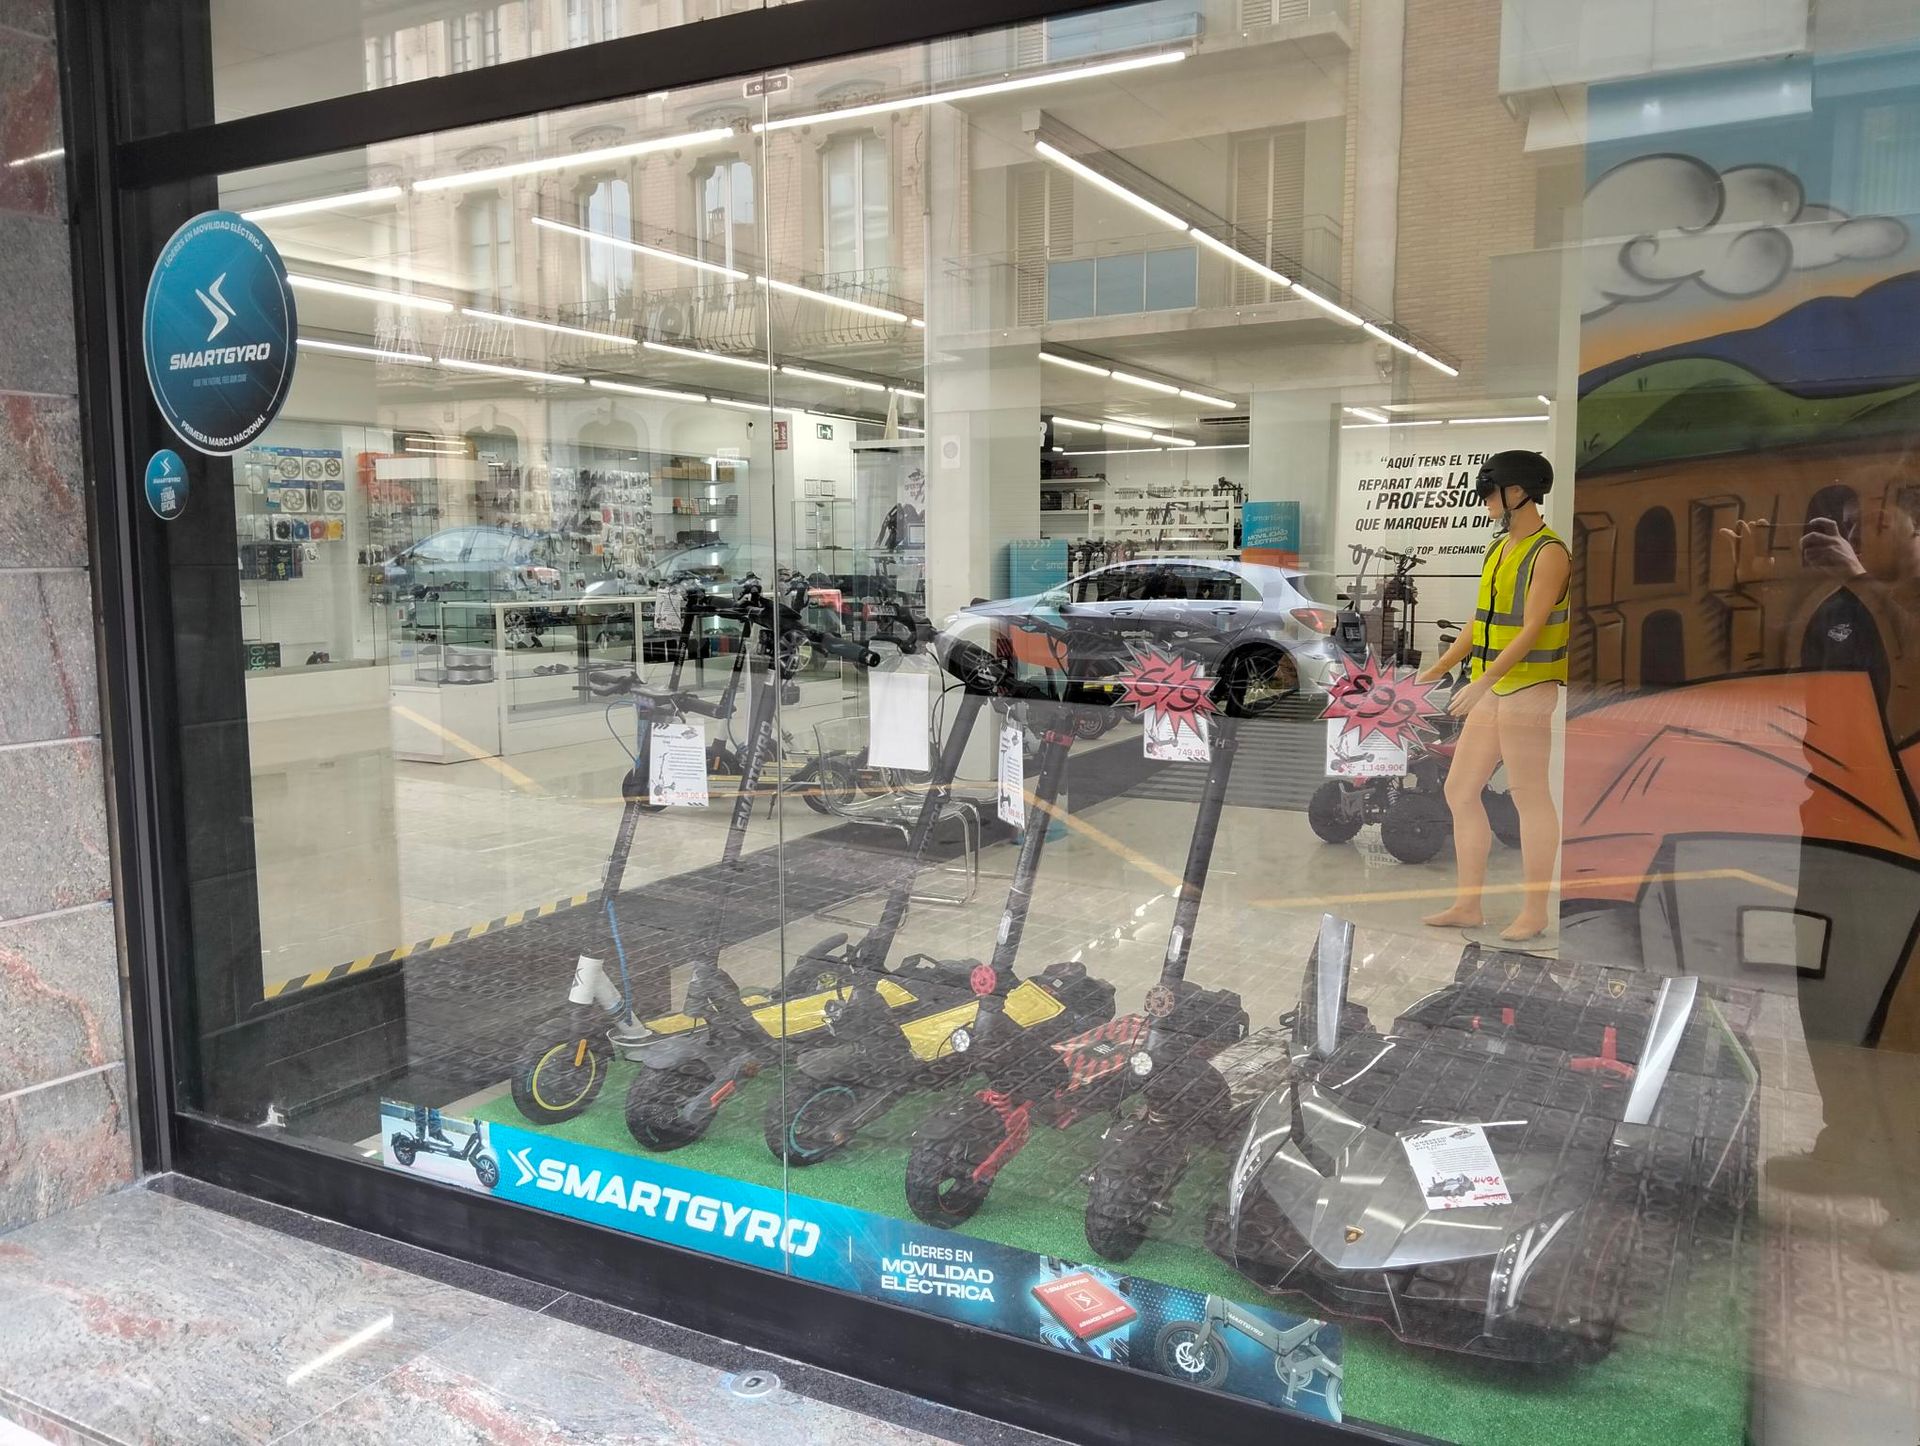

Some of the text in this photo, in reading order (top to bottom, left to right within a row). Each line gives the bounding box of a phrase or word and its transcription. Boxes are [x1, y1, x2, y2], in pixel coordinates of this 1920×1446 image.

[192, 220, 230, 236] MOVILIDAD
[230, 223, 264, 252] ELÉCTRICA
[169, 342, 271, 371] SMARTGYRO
[181, 414, 266, 447] PRIMERA MARCA NACIONAL
[1418, 456, 1447, 468] TENS
[1449, 454, 1462, 466] EL
[1358, 472, 1468, 490] REPARAT AMB LA
[1355, 518, 1381, 532] QUE
[1384, 516, 1449, 530] MARQUEN
[1452, 516, 1468, 528] LA
[536, 1158, 820, 1258] SMARTGYRO
[902, 1241, 973, 1263] LÍDERES EN
[882, 1257, 994, 1284] MOVILIDAD
[881, 1274, 995, 1302] ELÉCTRICA
